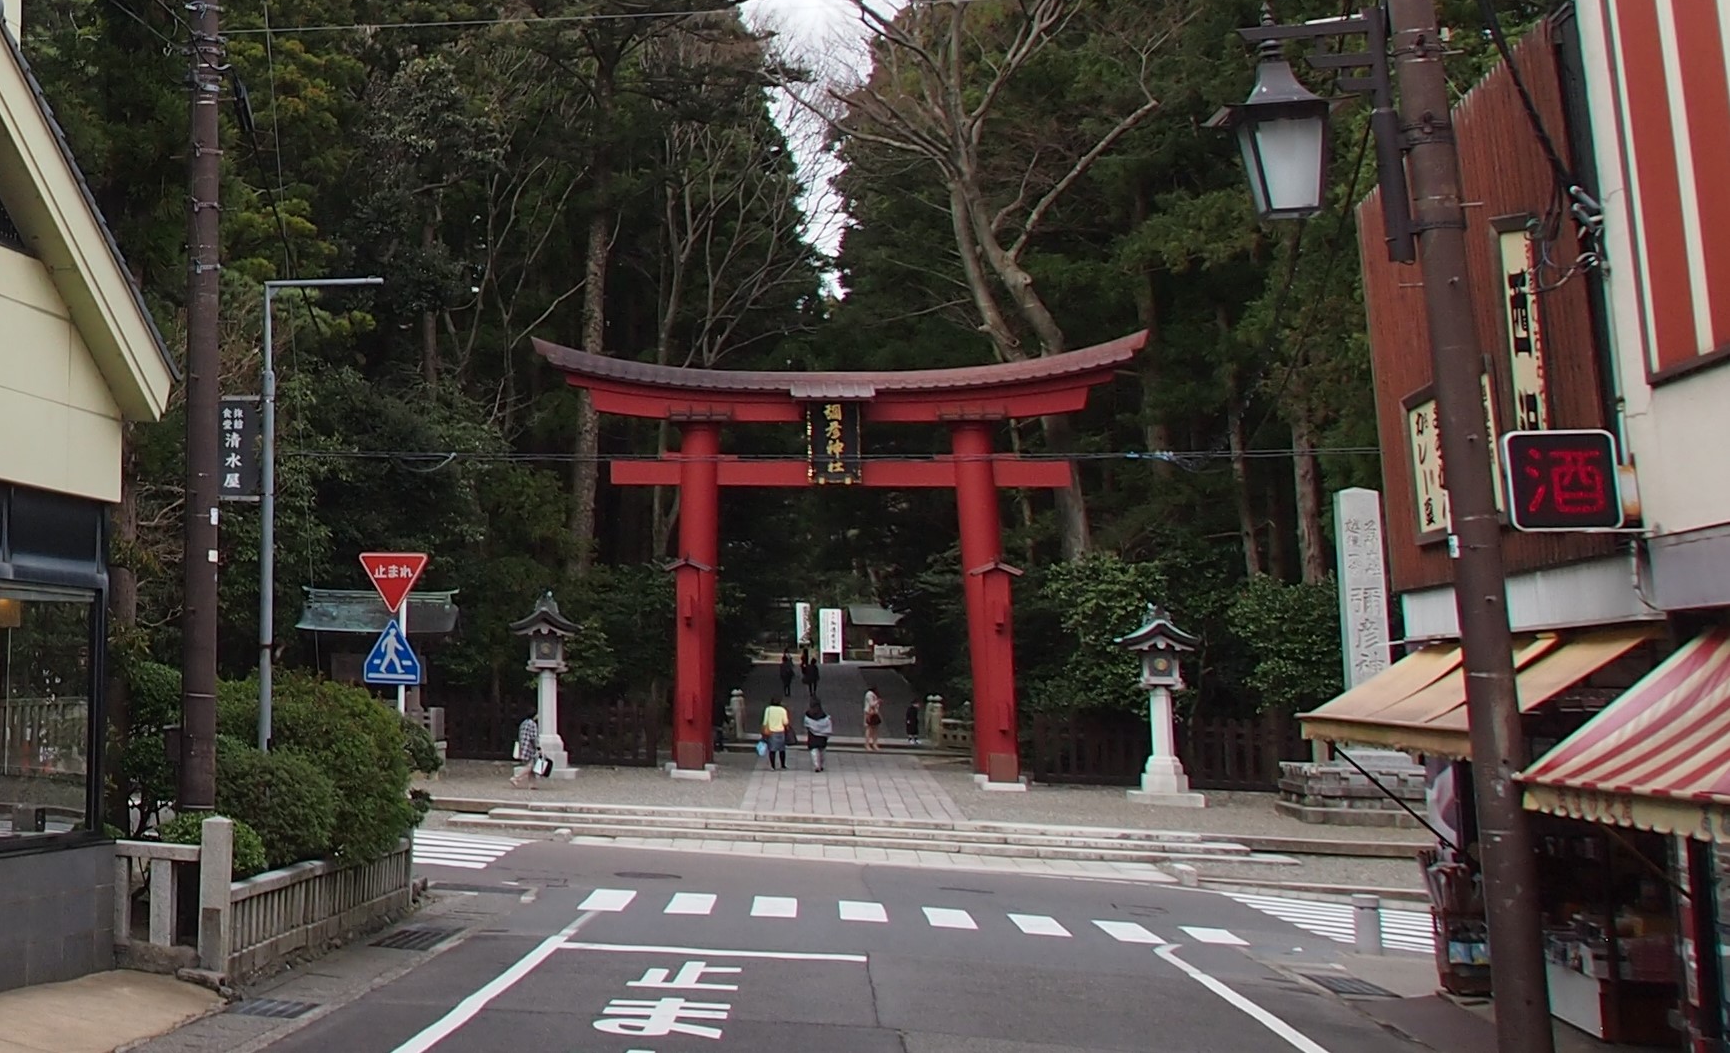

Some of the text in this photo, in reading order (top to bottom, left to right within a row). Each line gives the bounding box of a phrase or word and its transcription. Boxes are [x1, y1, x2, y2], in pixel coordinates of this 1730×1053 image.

[223, 432, 242, 489] 清水屋
[1527, 448, 1607, 515] 酒
[373, 564, 414, 580] 止まれ
[592, 960, 743, 1053] 止ま
